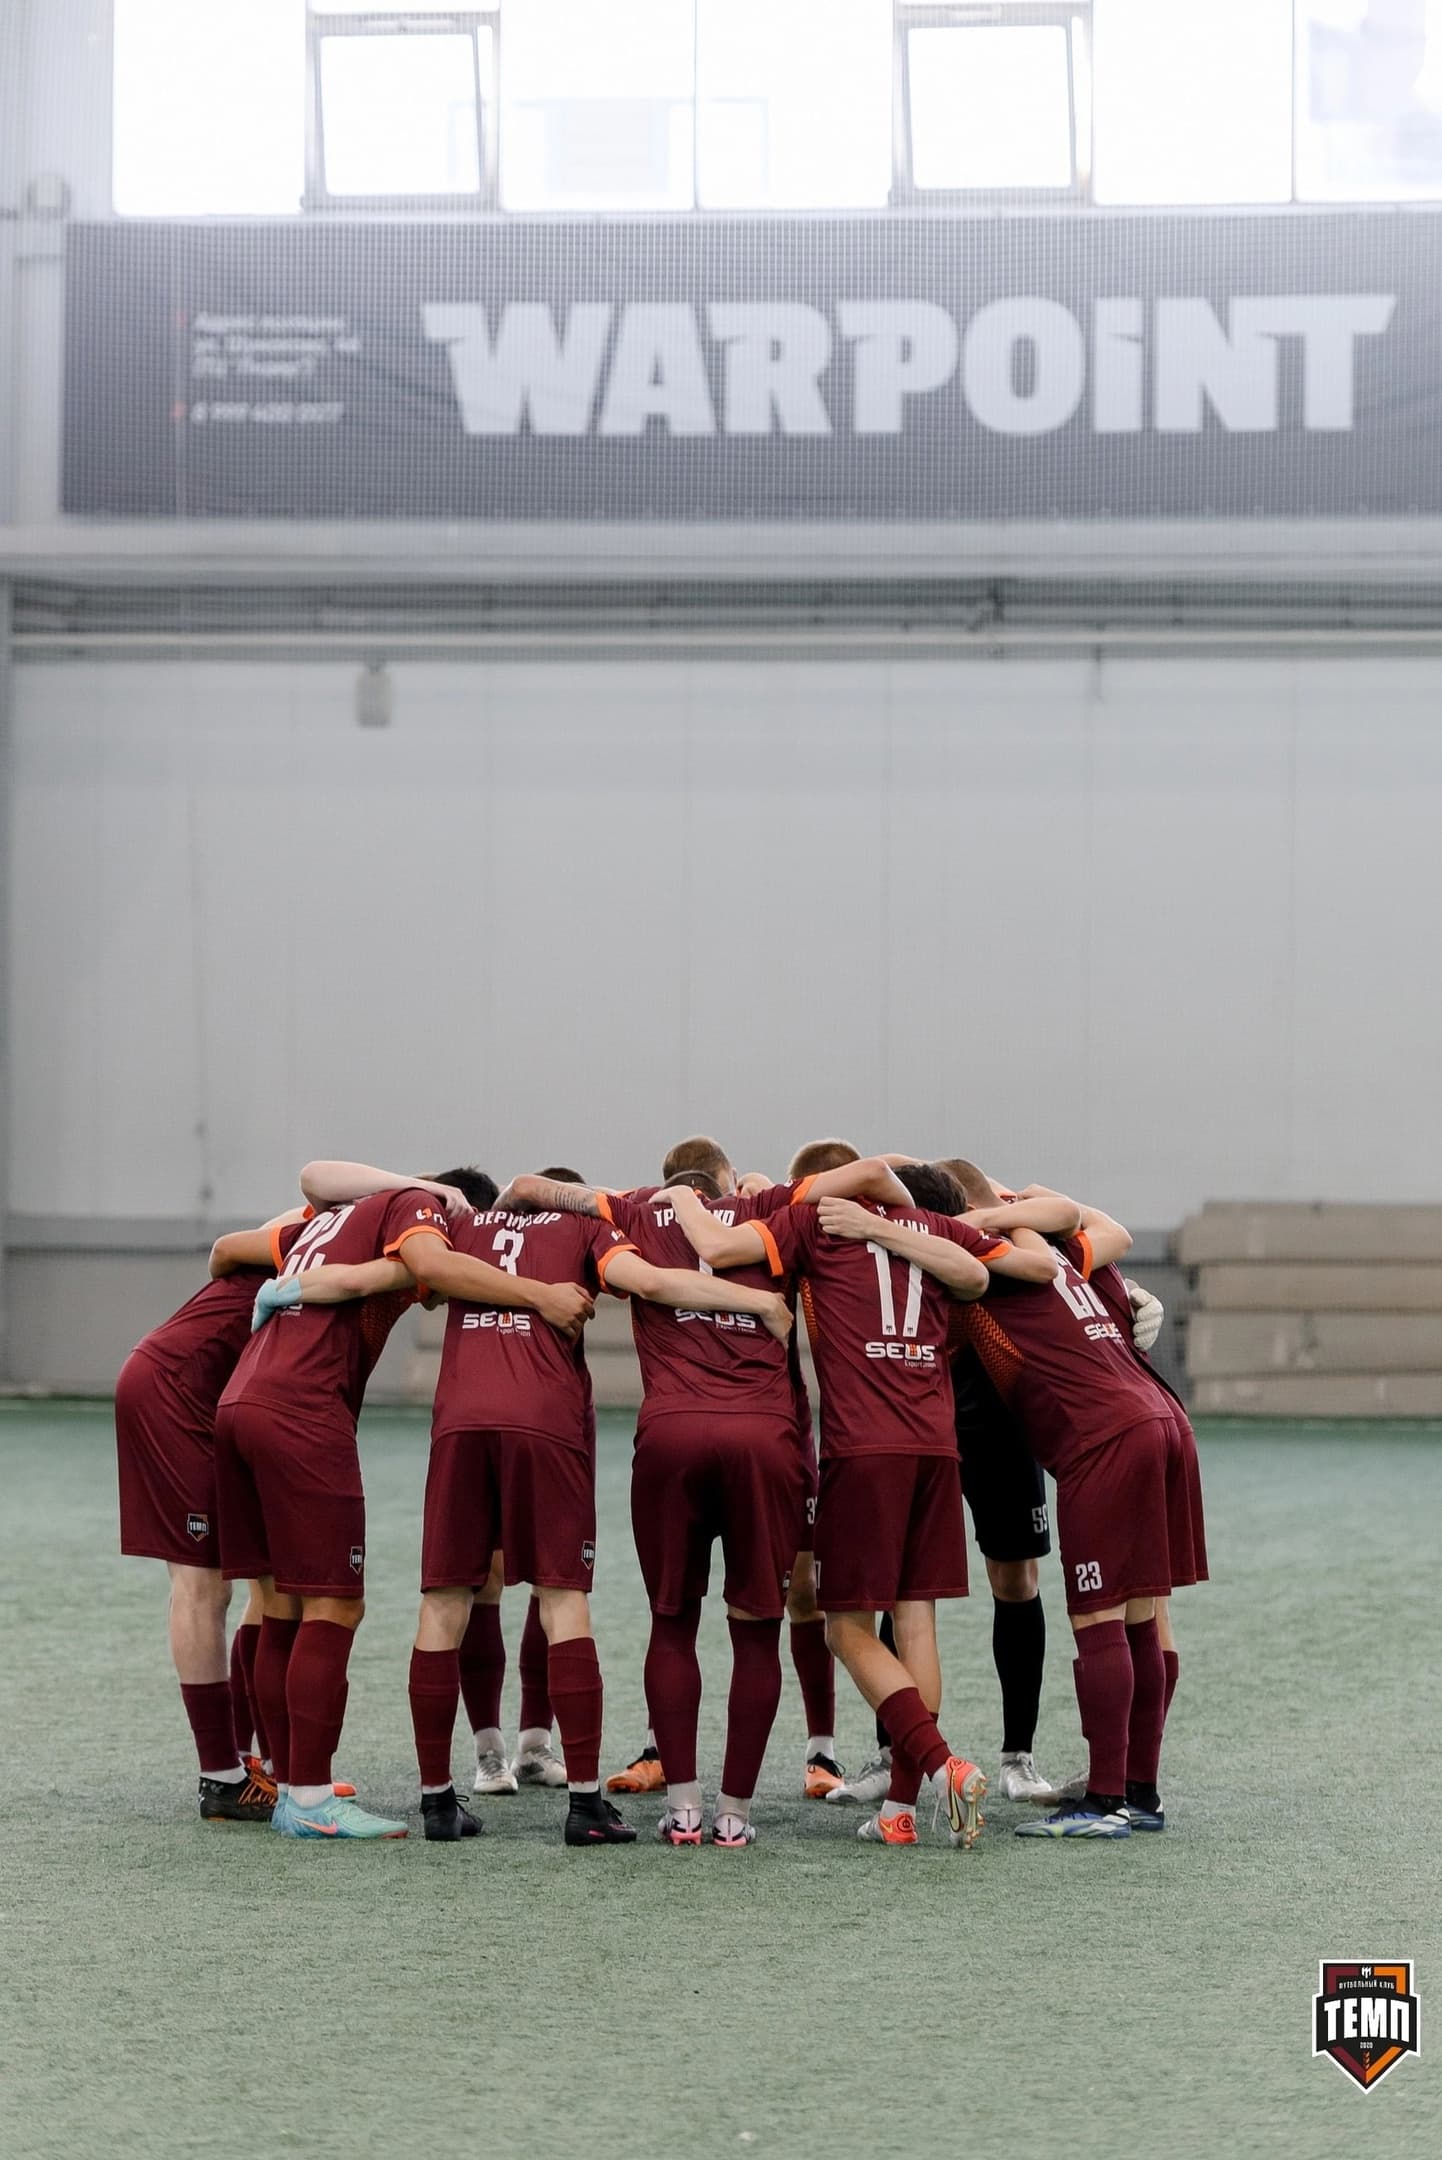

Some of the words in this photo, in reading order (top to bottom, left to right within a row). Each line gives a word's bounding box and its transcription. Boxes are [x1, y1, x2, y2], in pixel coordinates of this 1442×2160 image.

[421, 294, 1396, 437] WARPOINT
[492, 1228, 525, 1277] 3
[867, 1240, 923, 1337] 17
[462, 1311, 531, 1330] SEUS
[865, 1342, 936, 1361] SEUS
[1075, 1560, 1103, 1592] 23
